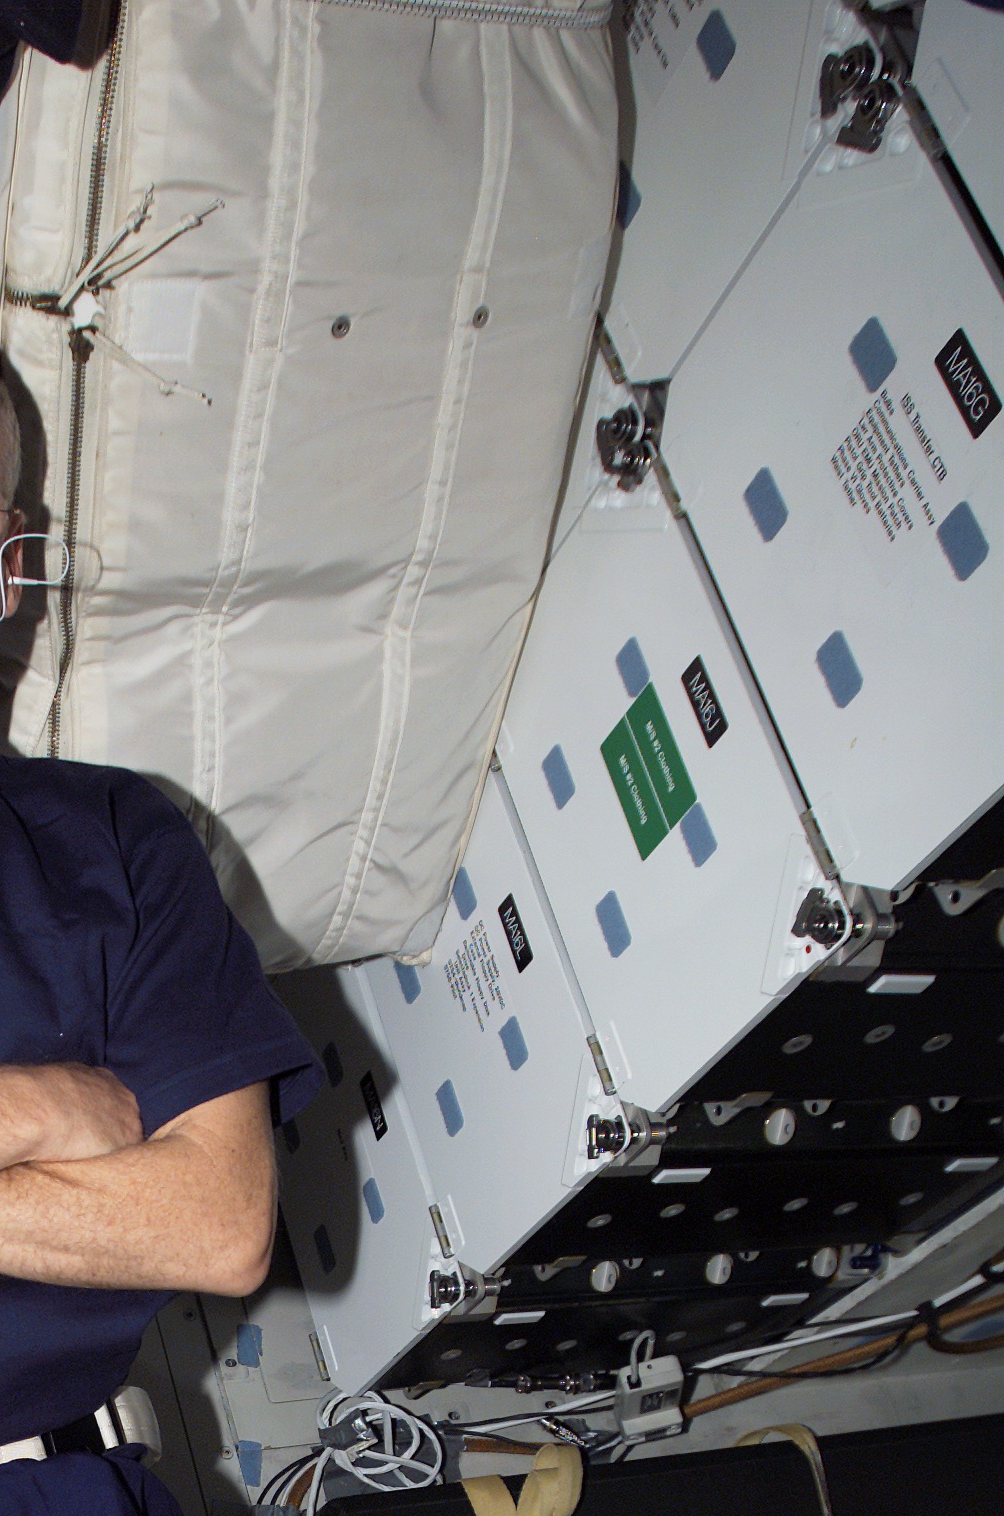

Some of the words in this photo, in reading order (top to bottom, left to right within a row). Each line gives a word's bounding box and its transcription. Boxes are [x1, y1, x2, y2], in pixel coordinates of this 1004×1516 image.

[881, 389, 894, 416] Bulbs
[945, 345, 989, 422] MA16G
[866, 408, 890, 454] Equipment
[888, 453, 905, 488] Tethers
[874, 400, 909, 470] Communications
[908, 470, 925, 501] Carrier
[922, 502, 936, 526] Assy
[900, 392, 915, 415] ISS
[911, 412, 934, 455] Transfer
[932, 456, 947, 482] CTB
[872, 468, 889, 504] Mission
[876, 453, 898, 498] Protective
[897, 498, 913, 530] Covers
[689, 671, 721, 731] MA16J
[646, 720, 657, 740] M/S
[658, 751, 676, 793] Clothing
[631, 785, 648, 825] Clothing
[504, 907, 525, 960] MA16L
